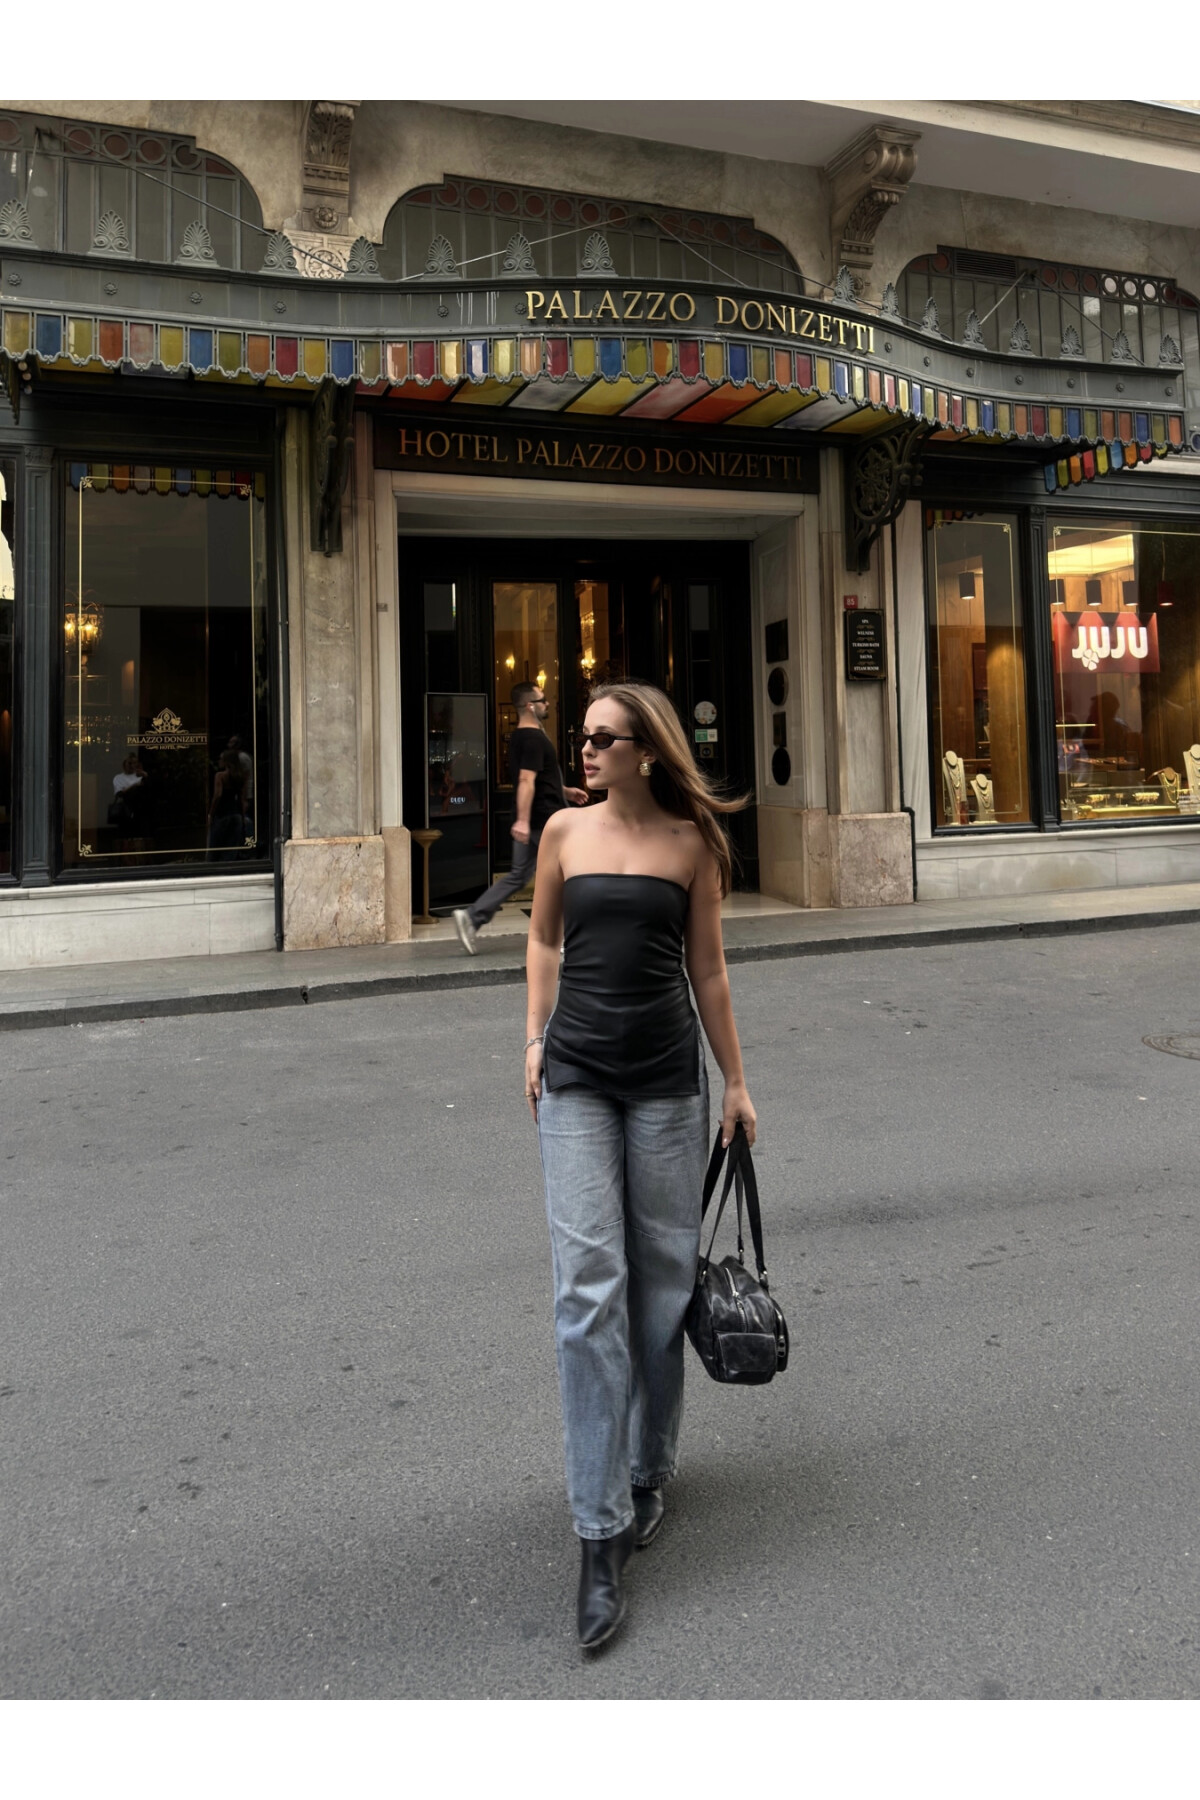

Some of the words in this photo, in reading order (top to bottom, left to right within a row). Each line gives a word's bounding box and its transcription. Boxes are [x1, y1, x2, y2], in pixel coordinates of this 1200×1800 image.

[524, 290, 696, 321] PALAZZO
[715, 296, 875, 353] DONIZETTI
[398, 428, 509, 462] HOTEL
[516, 438, 646, 472] PALAZZO
[653, 447, 801, 480] DONIZETTI
[1071, 625, 1149, 659] JUJU
[127, 736, 163, 744] PALAZZO
[164, 735, 207, 743] DONIZETTI
